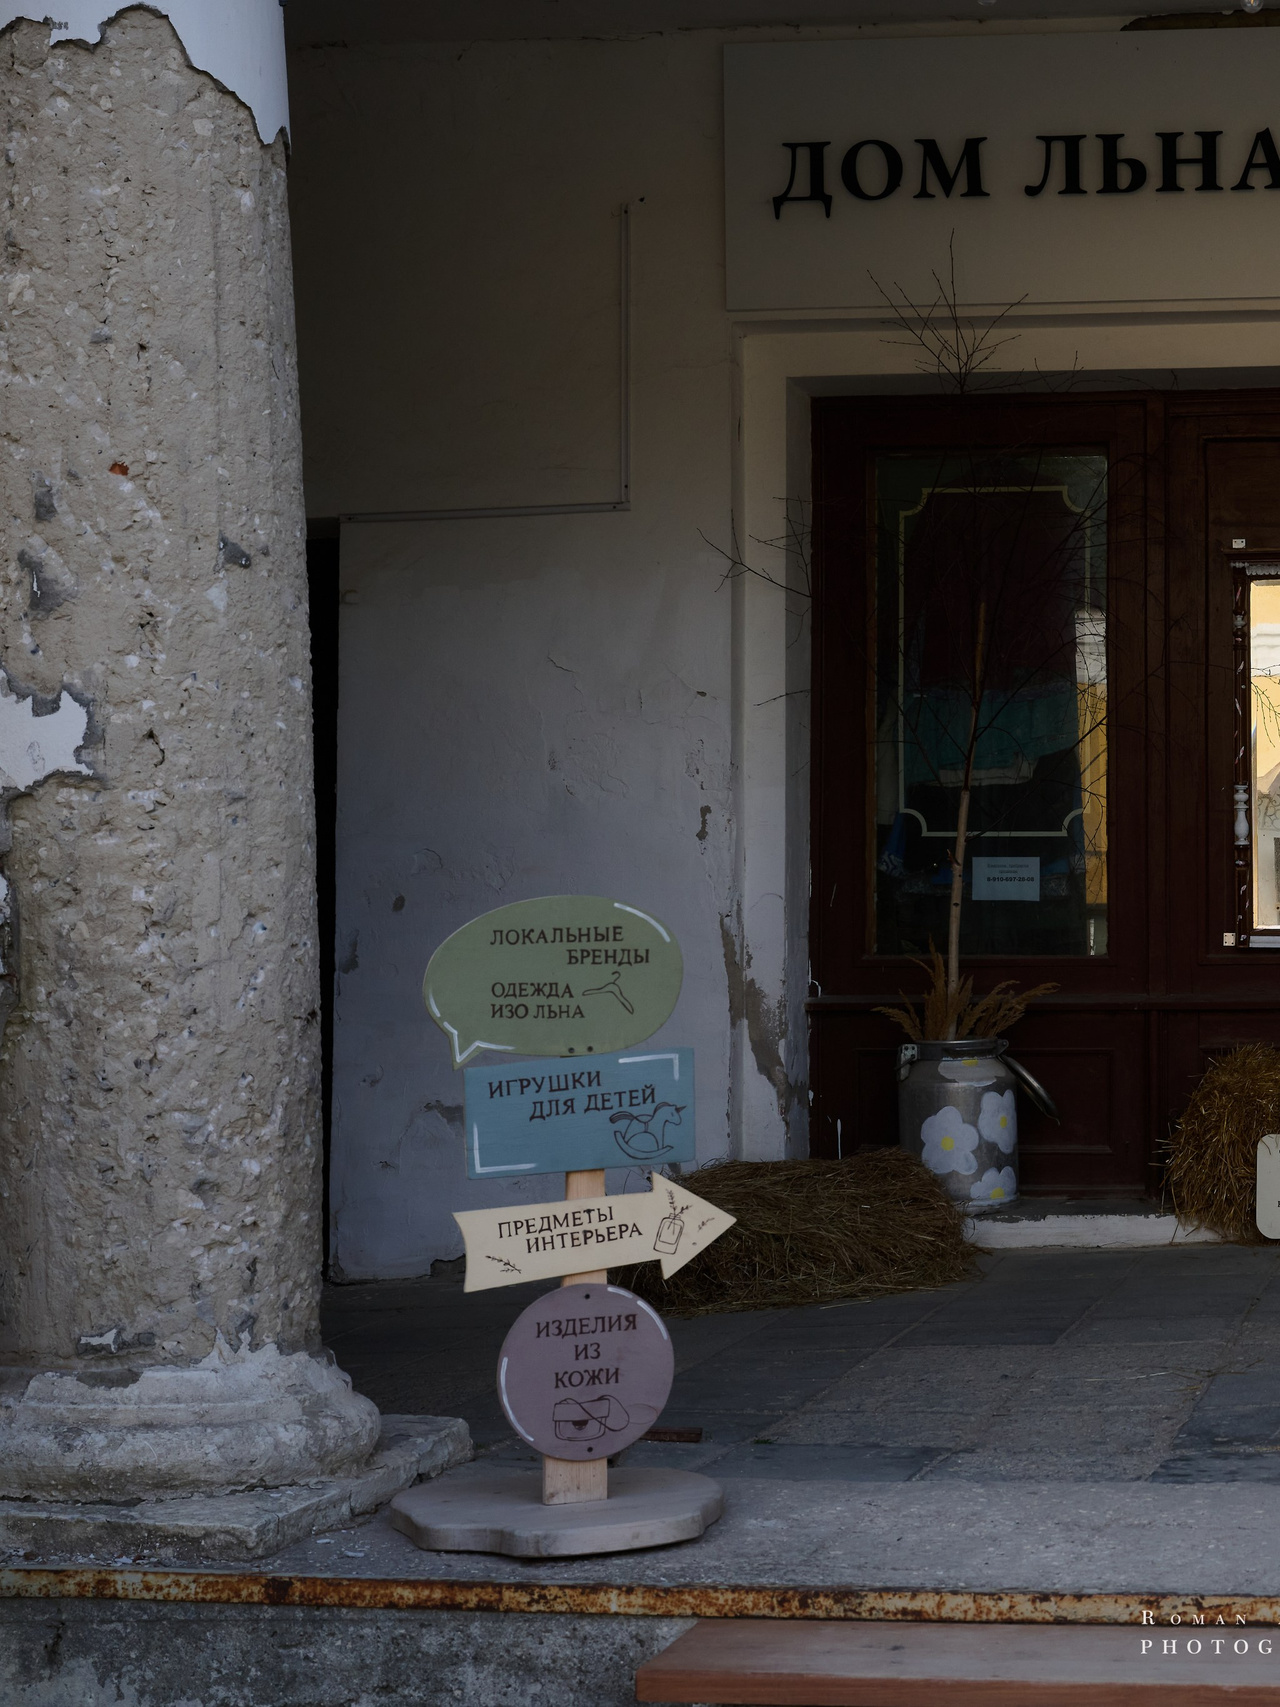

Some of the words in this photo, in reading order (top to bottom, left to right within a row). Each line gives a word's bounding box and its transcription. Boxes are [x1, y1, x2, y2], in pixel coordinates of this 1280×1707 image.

[772, 136, 990, 220] ДОМ
[490, 926, 624, 946] ЛОКАЛЬНЫЕ
[566, 948, 650, 967] БРЕНДЫ
[491, 982, 574, 999] ОДЕЖДА
[488, 1070, 602, 1099] ИГРУШКИ
[529, 1098, 576, 1122] ДЛЯ
[584, 1084, 656, 1112] ДЕТЕЙ
[497, 1206, 614, 1239] ПРЕДМЕТЫ
[526, 1222, 643, 1254] ИНТЕРЬЕРА
[536, 1313, 638, 1339] ИЗДЕЛИЯ
[574, 1342, 601, 1361] ИЗ
[554, 1367, 620, 1389] КОЖИ
